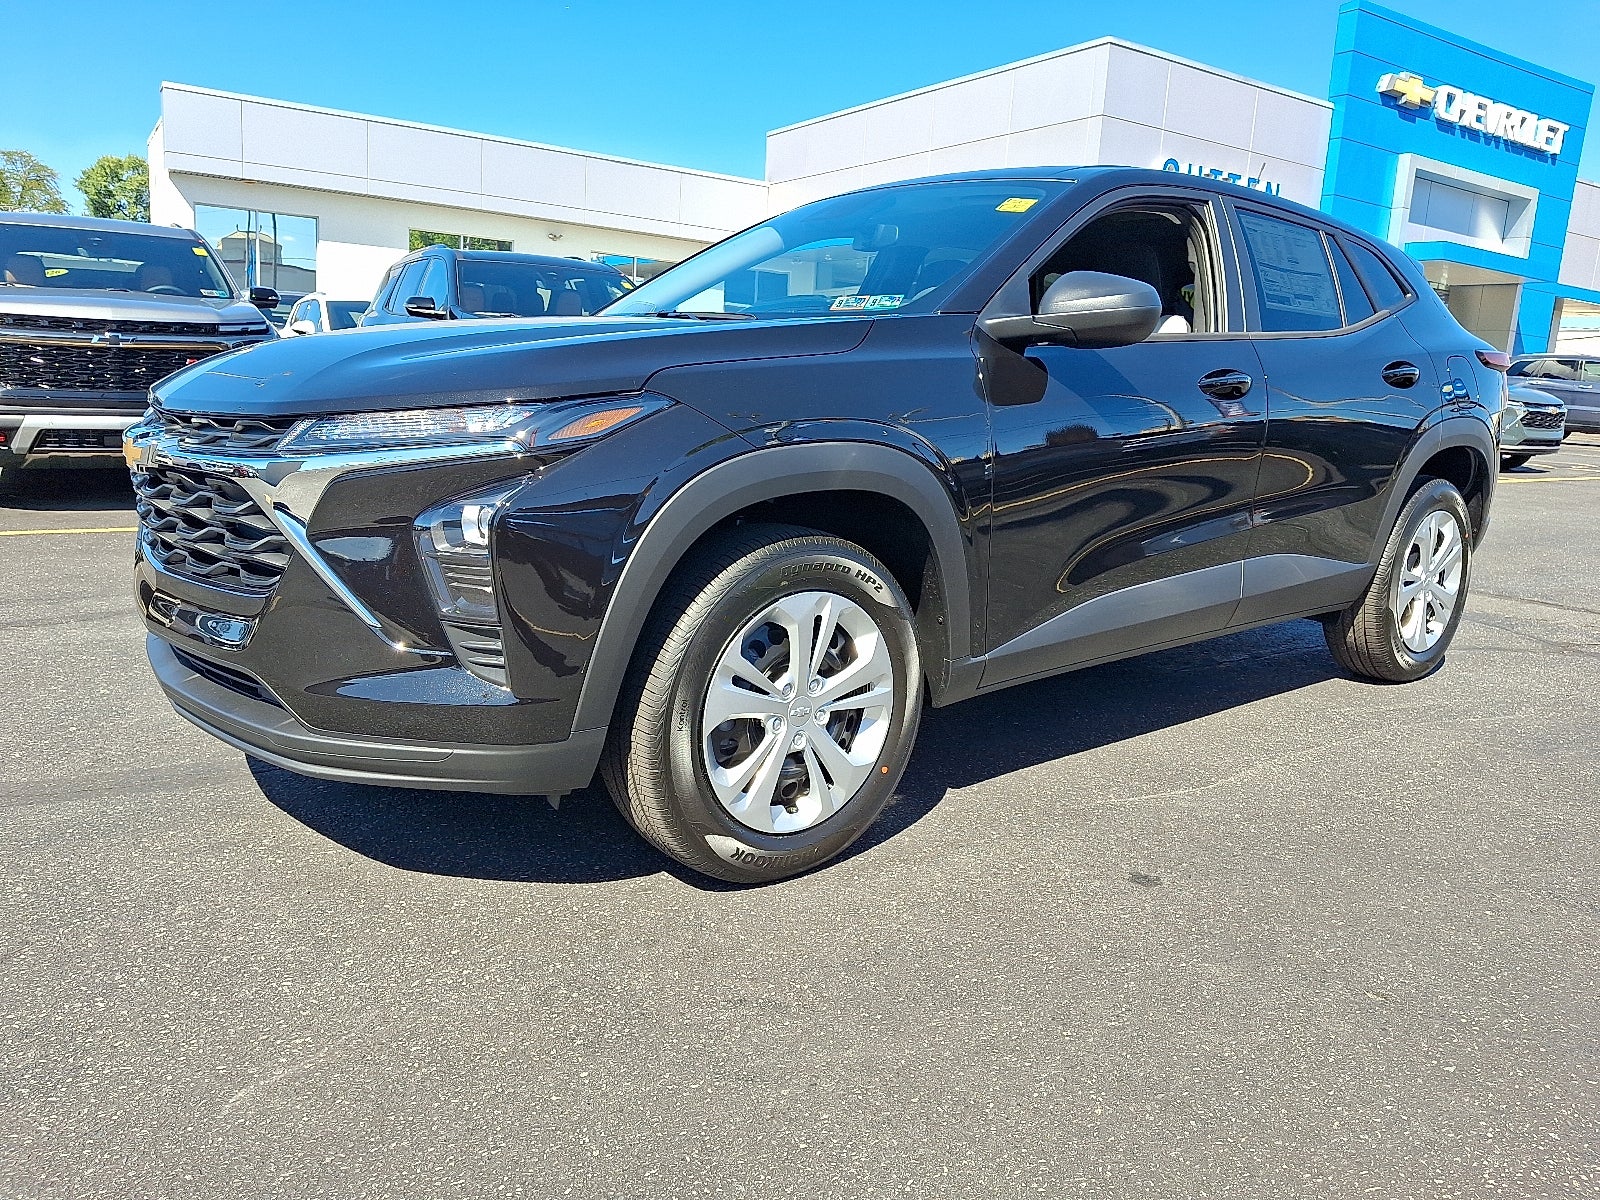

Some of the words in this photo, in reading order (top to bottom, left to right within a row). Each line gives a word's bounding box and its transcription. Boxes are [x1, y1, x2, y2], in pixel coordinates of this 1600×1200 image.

[1434, 84, 1570, 155] CHEVROLET
[854, 569, 884, 594] HP2
[677, 699, 688, 732] Kontrol
